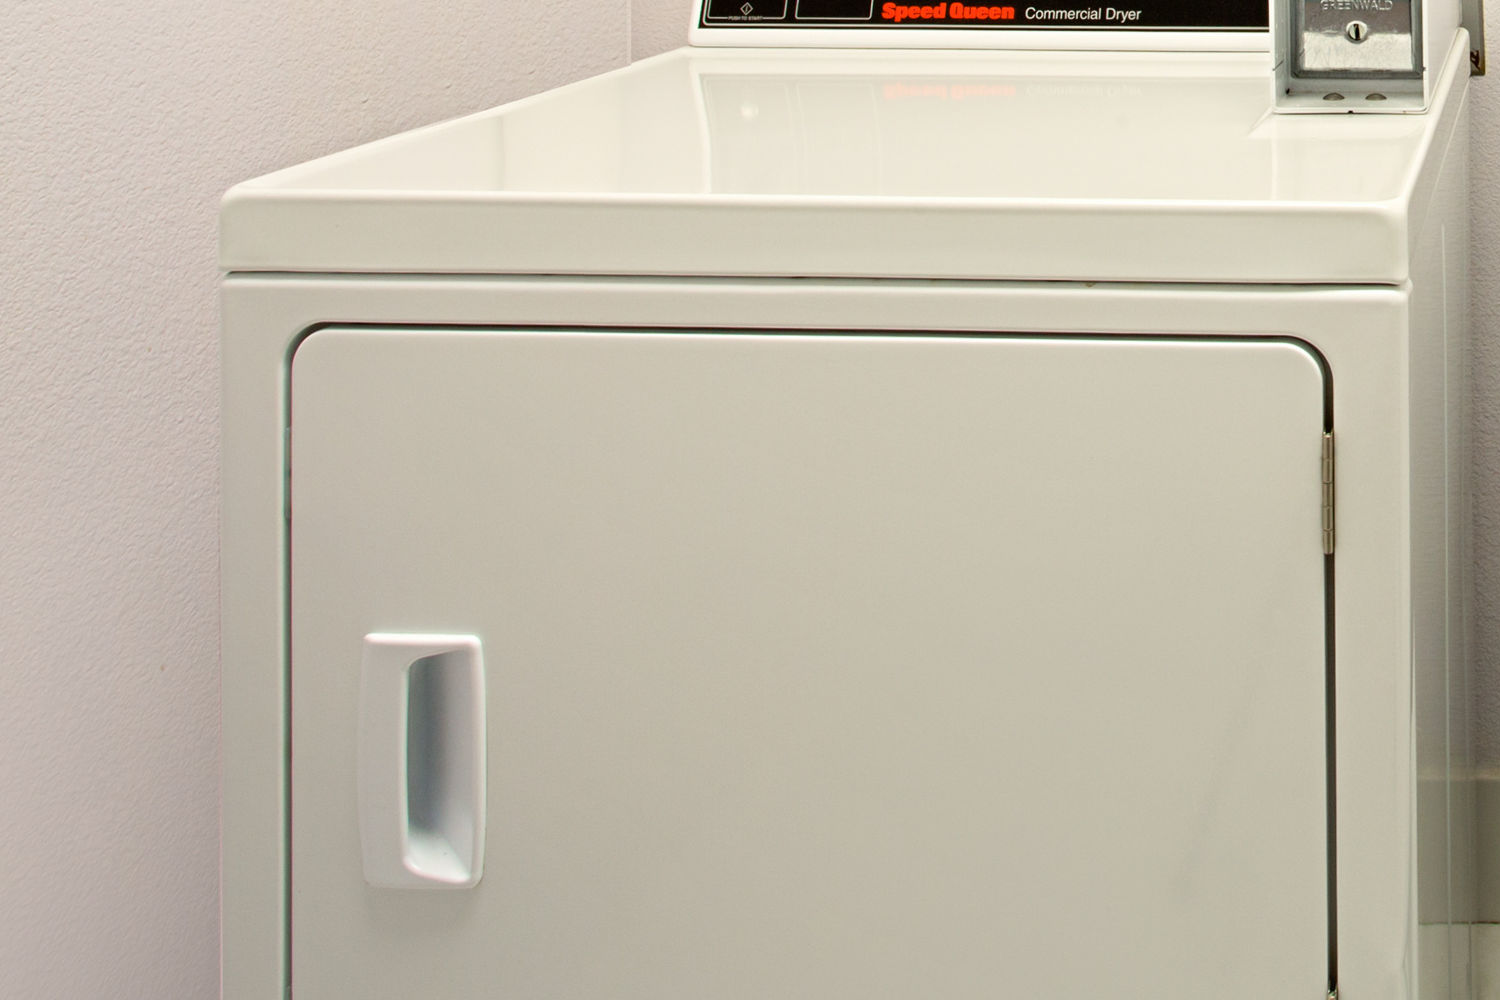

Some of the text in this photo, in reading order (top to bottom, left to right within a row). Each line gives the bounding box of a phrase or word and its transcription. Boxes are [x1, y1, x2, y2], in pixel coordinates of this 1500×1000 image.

[881, 2, 1142, 24] Speed Queen Commercial Dryer
[1319, 0, 1394, 11] GREENWALD
